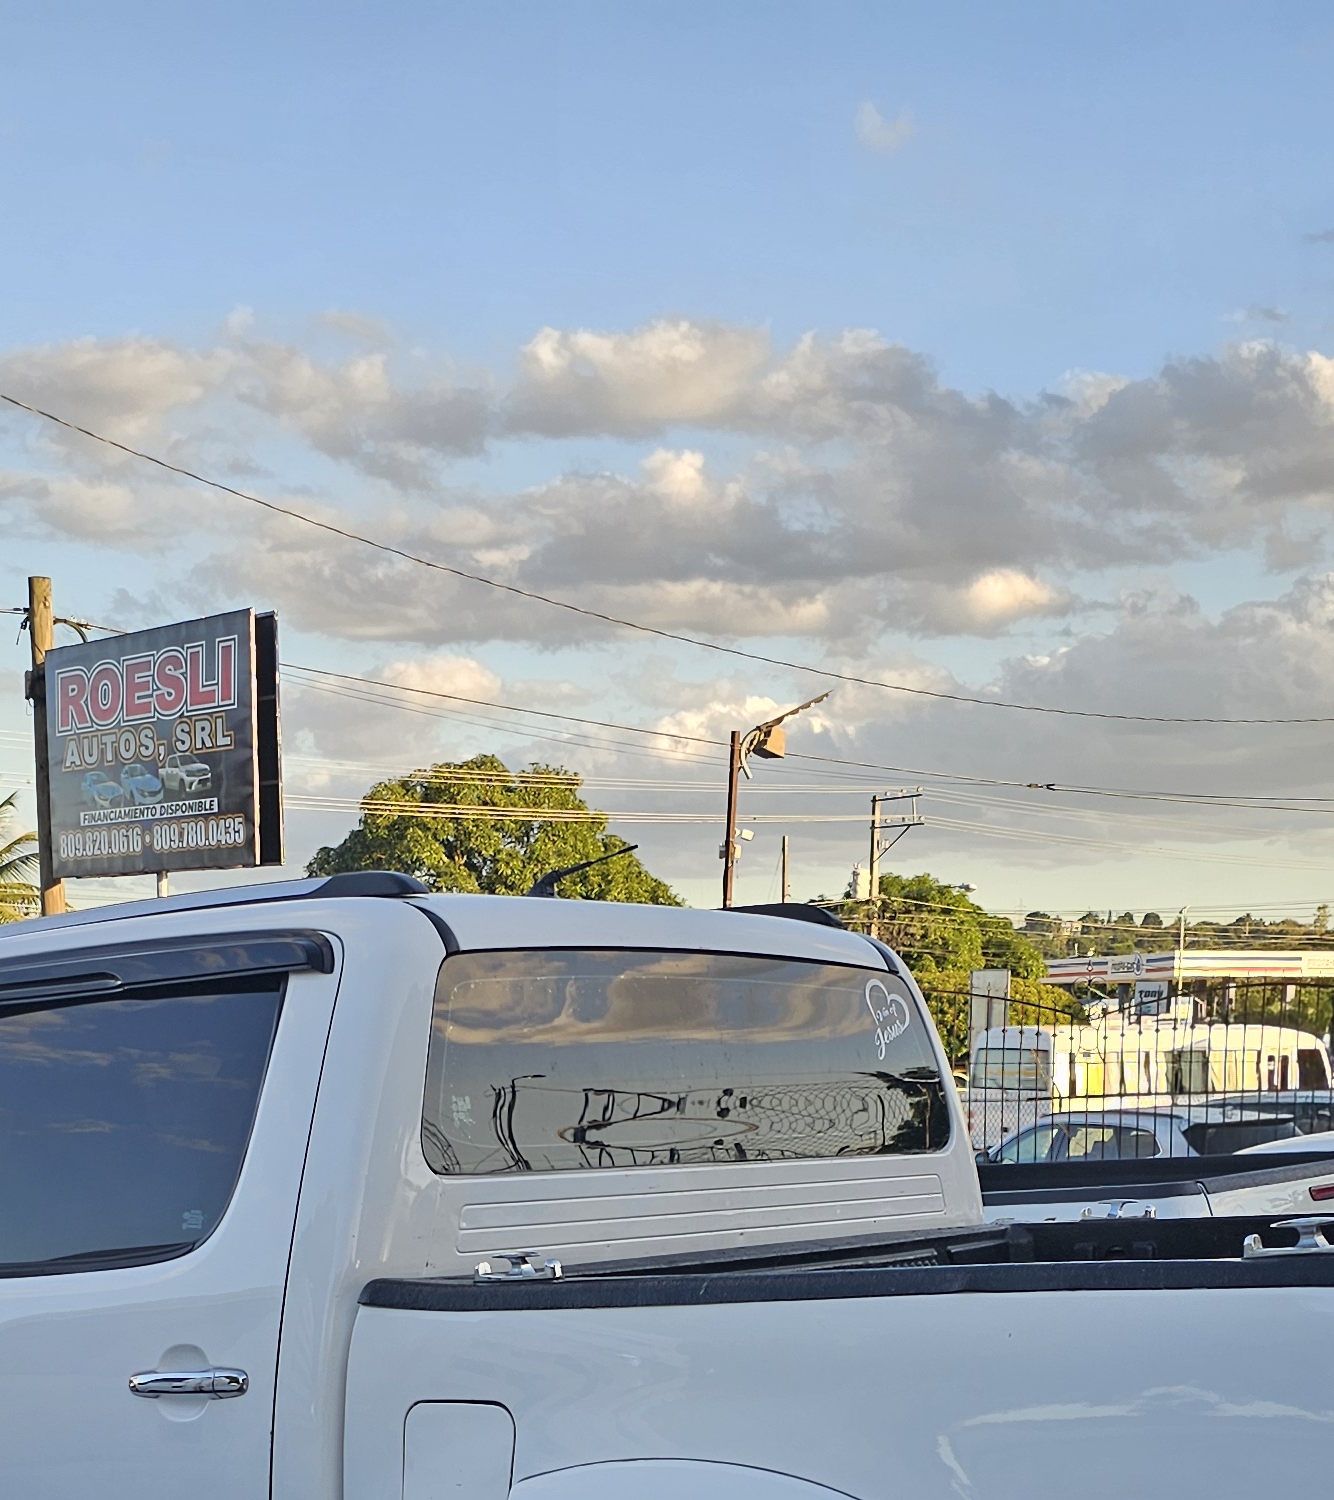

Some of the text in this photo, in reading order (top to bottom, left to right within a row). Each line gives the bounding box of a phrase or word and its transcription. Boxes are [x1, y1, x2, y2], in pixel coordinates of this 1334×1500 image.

[56, 635, 238, 736] ROESLI
[64, 714, 234, 770] AUTOS, SRL
[82, 799, 216, 824] FINANCIAMIENTO DISPONIBLE
